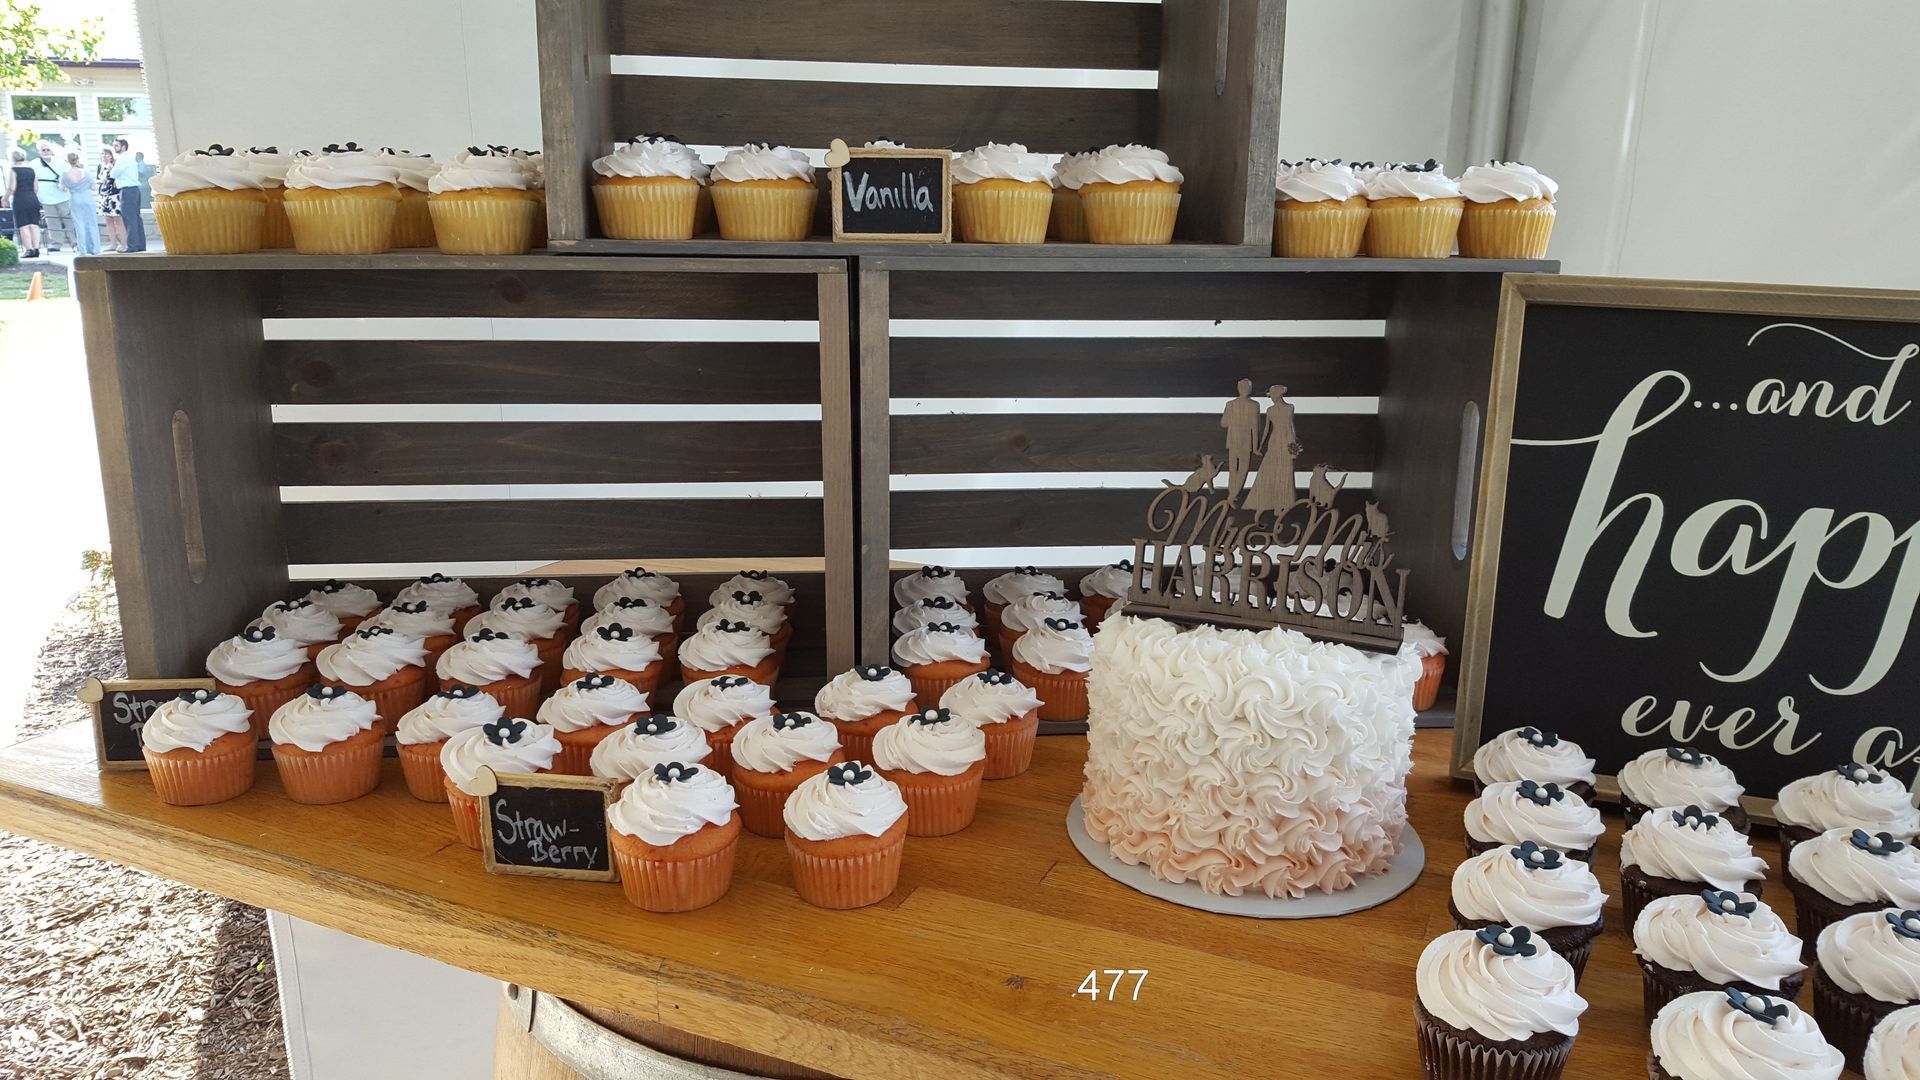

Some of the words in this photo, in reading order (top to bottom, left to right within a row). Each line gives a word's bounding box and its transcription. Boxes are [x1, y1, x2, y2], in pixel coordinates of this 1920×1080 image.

[843, 171, 934, 213] Vanilla
[1147, 486, 1241, 551] Mr
[1238, 506, 1276, 552] &
[1272, 498, 1396, 574] Mrs
[1128, 537, 1411, 630] HARRISON
[113, 692, 170, 724] Str
[1621, 695, 1823, 756] ever
[495, 799, 580, 845] Straw-
[527, 839, 598, 869] Berry
